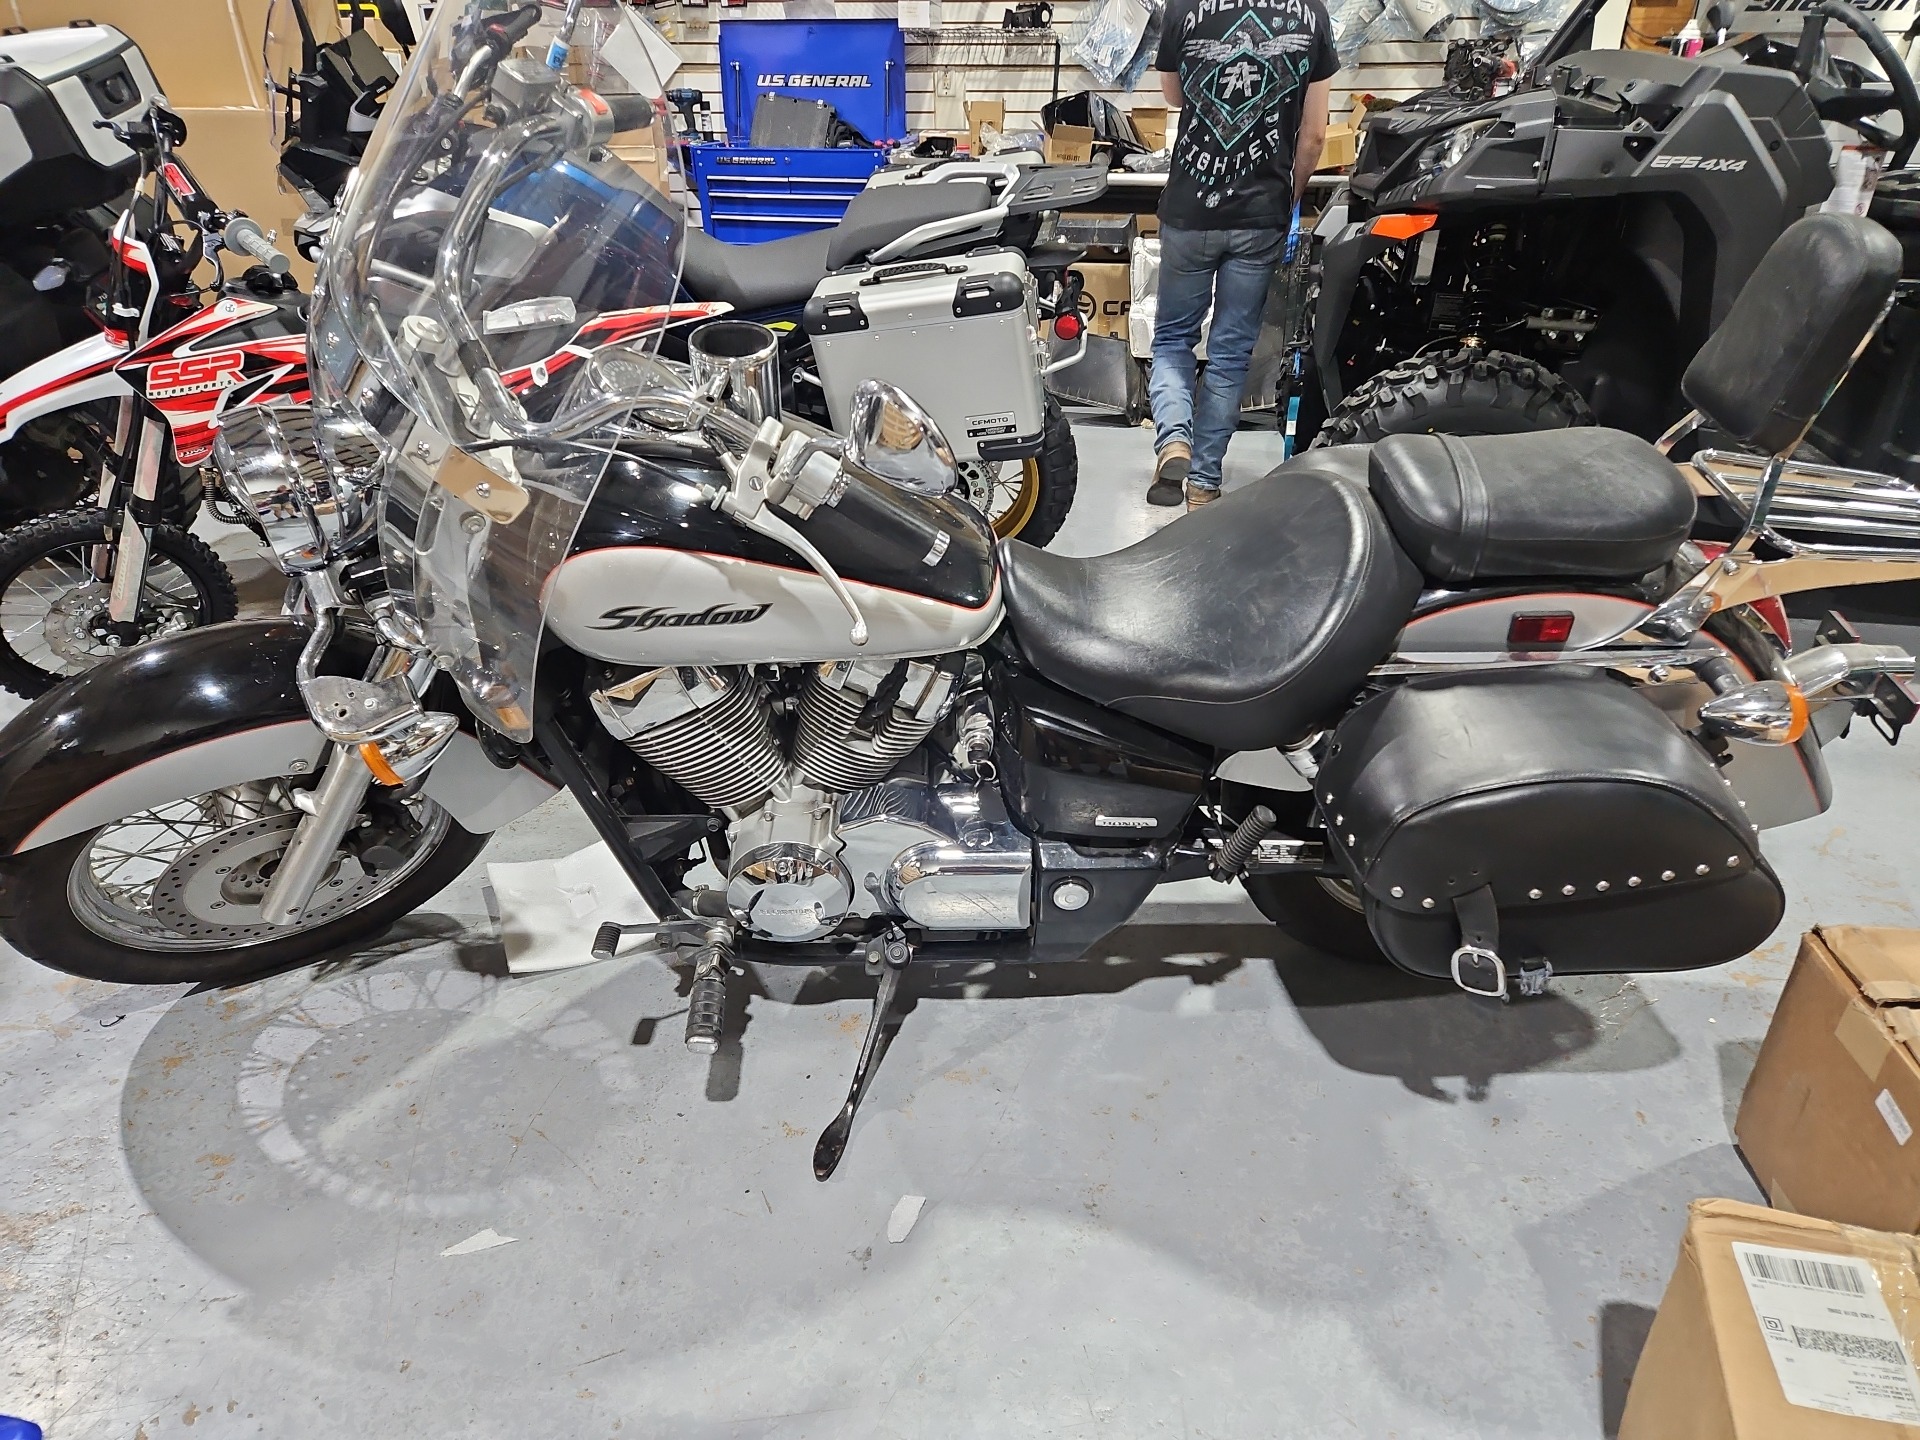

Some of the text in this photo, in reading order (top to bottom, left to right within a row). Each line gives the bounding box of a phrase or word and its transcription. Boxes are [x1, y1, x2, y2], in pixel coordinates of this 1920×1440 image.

[788, 75, 872, 88] GENERAL
[1650, 155, 1703, 169] EPS
[149, 352, 247, 391] SSR
[148, 379, 233, 397] MOTORSPORTS
[971, 416, 1009, 426] CFMOTO
[583, 602, 774, 633] Shadow
